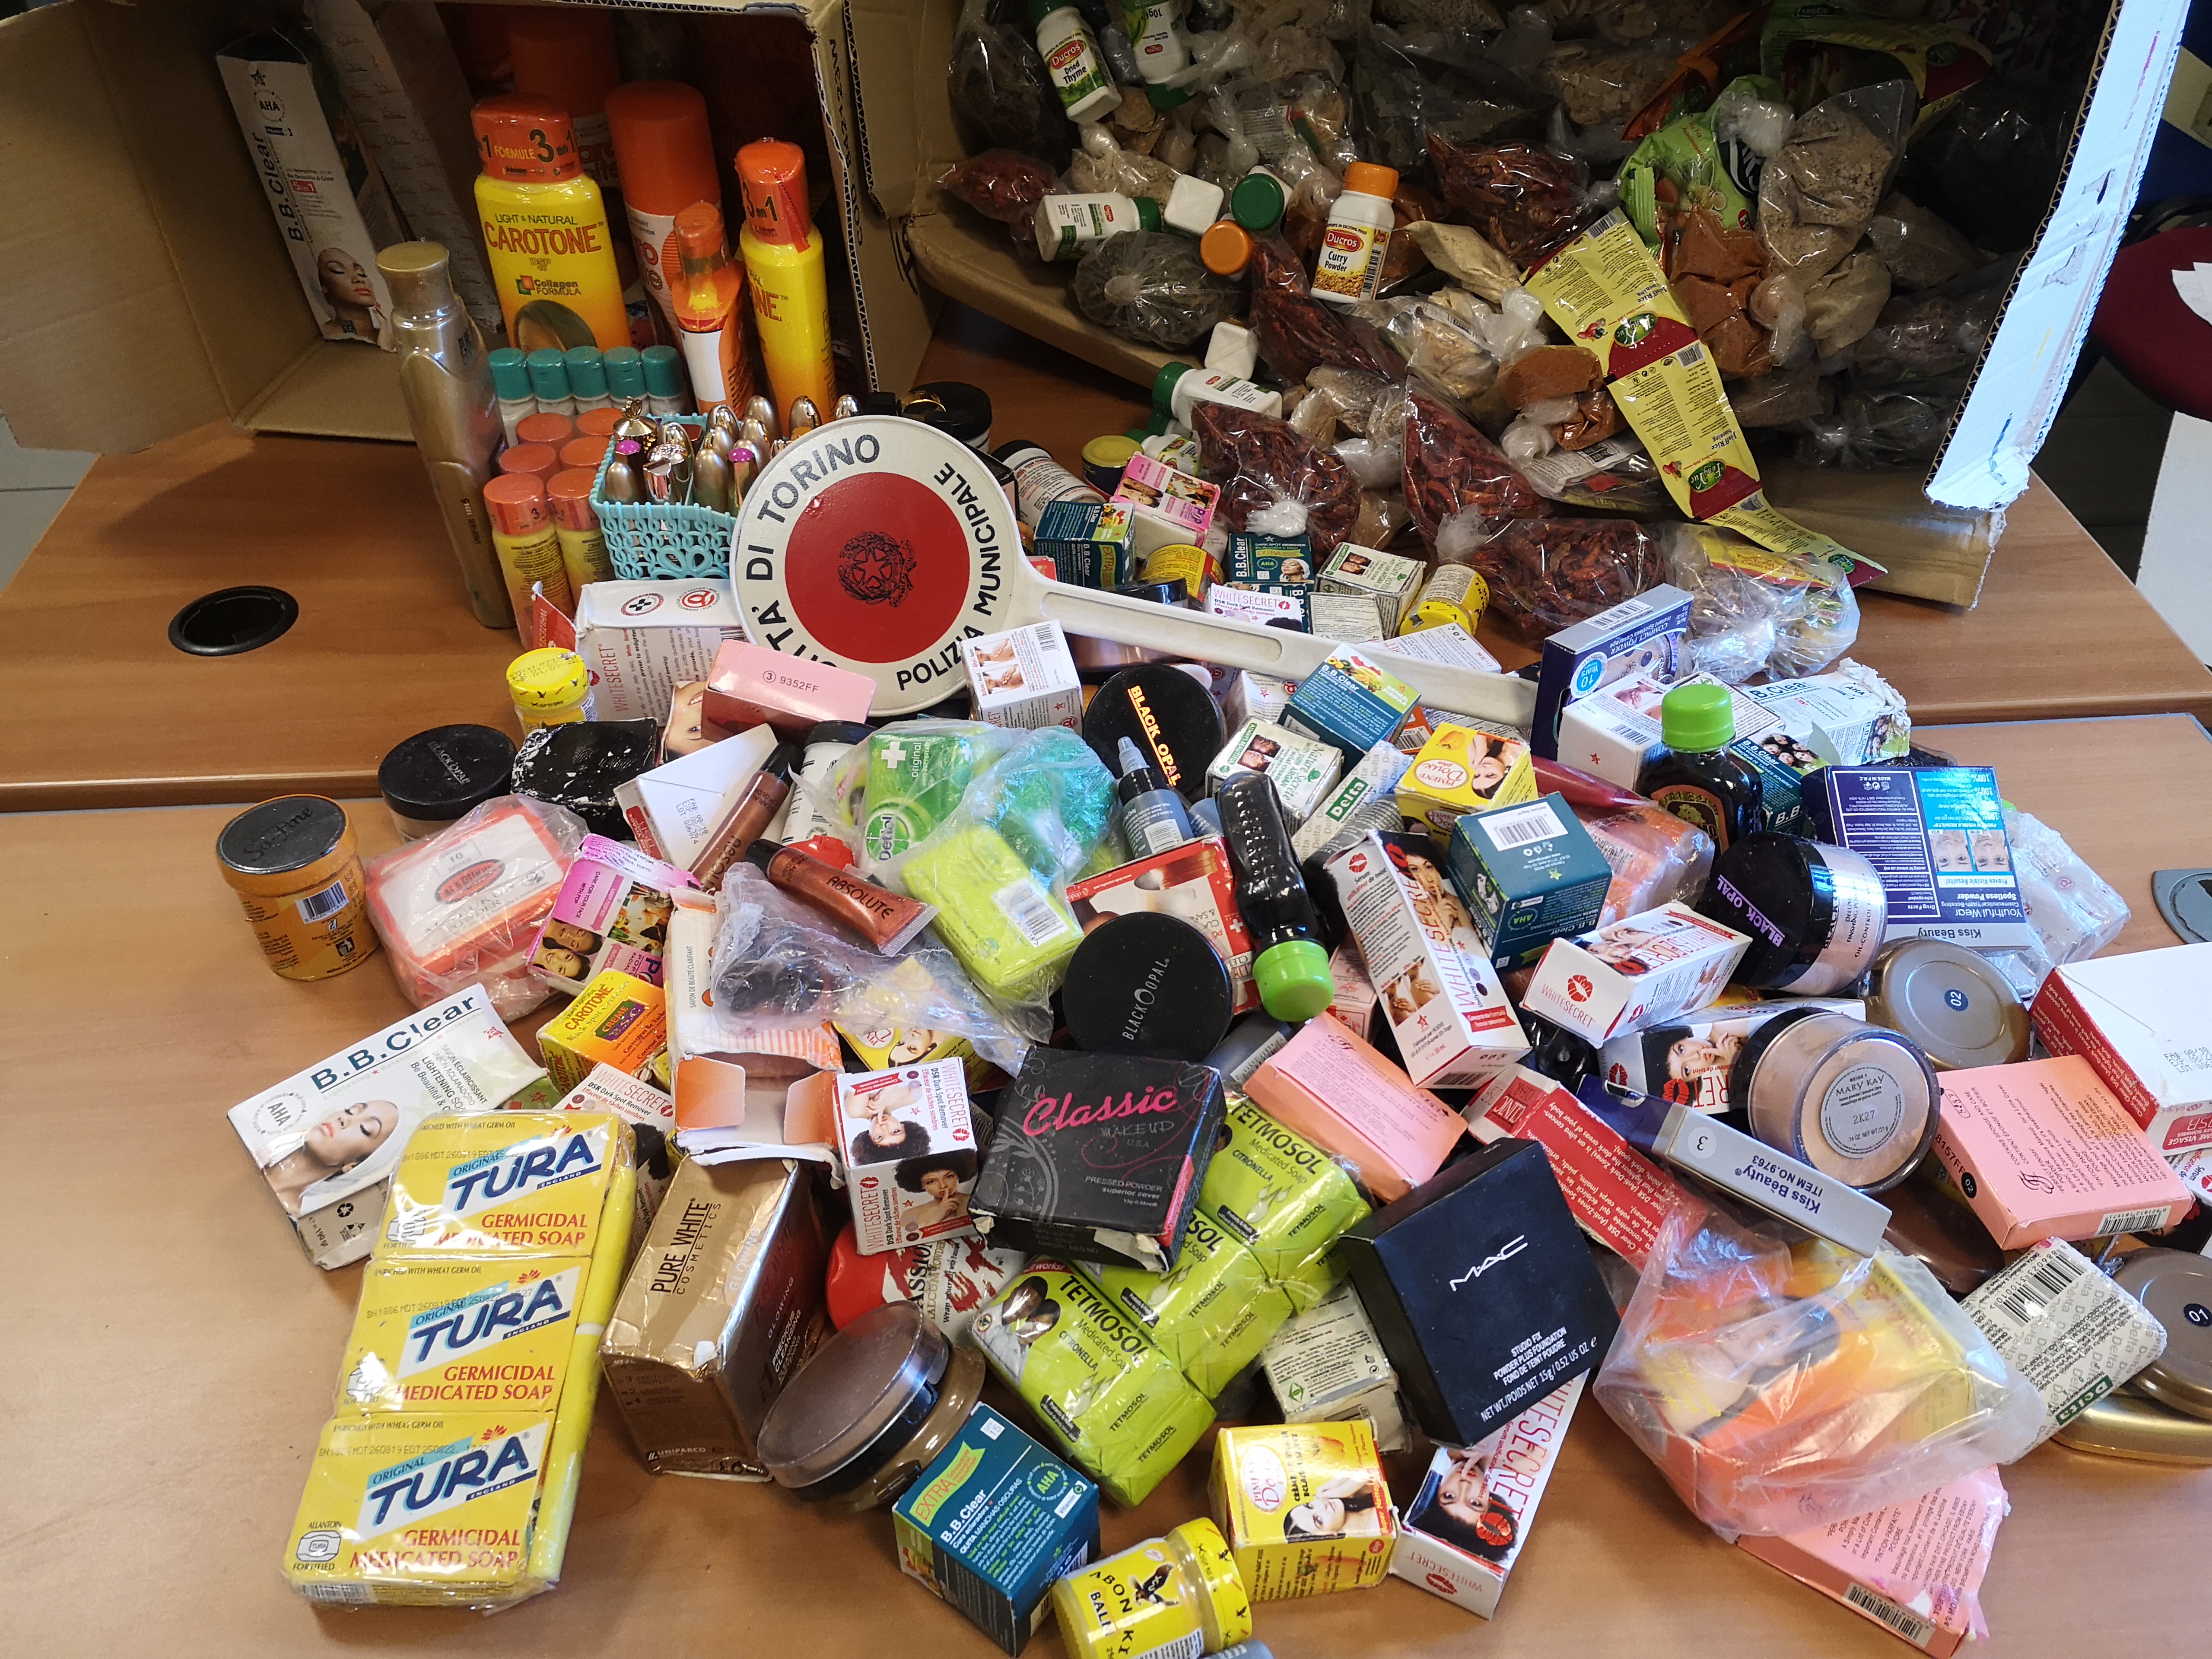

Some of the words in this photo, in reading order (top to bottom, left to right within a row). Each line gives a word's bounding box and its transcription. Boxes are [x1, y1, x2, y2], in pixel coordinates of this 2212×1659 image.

[1050, 42, 1081, 67] Ducros
[1064, 60, 1080, 75] Dried
[1063, 65, 1087, 84] Thyme
[259, 100, 280, 112] AHA
[494, 145, 536, 161] FORMULE
[529, 128, 555, 163] 3
[483, 221, 602, 255] CAROTONE
[1326, 231, 1358, 246] Ducros
[1324, 260, 1348, 273] Powder
[1328, 251, 1348, 264] Curry
[534, 279, 578, 289] Collagen
[536, 286, 582, 296] FORMULA
[756, 434, 880, 524] TORINO
[933, 462, 1001, 616] MUNICIPALE
[746, 544, 775, 581] DI
[1236, 537, 1248, 578] B.B.Clear
[1213, 589, 1280, 608] WHITESECRET
[1611, 638, 1638, 655] POWDER
[1638, 623, 1668, 643] COMPACT
[599, 647, 629, 712] WHITESECRET
[1321, 664, 1360, 692] B.B.Clear
[1581, 664, 1599, 676] Years
[1582, 674, 1594, 688] 10
[779, 676, 820, 693] 9352FF
[1844, 684, 1867, 696] AHA
[1127, 684, 1161, 736] BLACK
[1158, 742, 1182, 787] OPAL
[911, 741, 922, 778] original
[1303, 744, 1324, 772] Nature
[1743, 739, 1780, 766] B.B.Clear
[1283, 772, 1306, 801] Secrete
[878, 815, 895, 861] Dettol
[449, 852, 464, 863] 10
[826, 874, 895, 920] ABSOLUTE
[1716, 873, 1744, 911] OPAL
[1513, 913, 1534, 925] AHA
[1550, 916, 1598, 937] B.B.Clear
[1955, 908, 1981, 918] Wear
[1983, 909, 2023, 918] Youthful
[1397, 869, 1476, 1008] WHITESECRET
[1745, 909, 1787, 949] BLACK
[1918, 928, 1955, 940] Beauty
[1958, 928, 1981, 938] Kiss
[565, 983, 613, 1031] CAROTONE
[1541, 983, 1594, 1029] WHITESECRET
[1950, 991, 1962, 1007] 02
[1122, 1004, 1148, 1041] BLACK
[310, 995, 475, 1091] B.B.Clear
[411, 1062, 420, 1072] Be
[417, 1071, 442, 1100] Beautiful
[422, 1056, 455, 1098] LIGHTENING
[442, 1044, 457, 1063] SAVON
[454, 1061, 487, 1104] ÉCLAIRCISSANT
[1836, 1081, 1863, 1096] MARY
[1867, 1074, 1885, 1087] KAY
[588, 1082, 601, 1091] DSR
[601, 1088, 614, 1098] Dark
[613, 1094, 626, 1104] Spot
[626, 1101, 652, 1116] Remover
[595, 1069, 668, 1110] WHITESECRET
[941, 1062, 969, 1131] WHITESECRET
[267, 1102, 291, 1127] AHA
[1022, 1085, 1178, 1137] Classic
[1853, 1110, 1875, 1125] 2K27
[1231, 1101, 1323, 1175] TETMOSOL
[1548, 1102, 1564, 1116] body
[1562, 1115, 1577, 1127] your
[1582, 1130, 1599, 1146] areas
[1597, 1144, 1611, 1157] dark
[1697, 1136, 1709, 1151] 3
[1232, 1149, 1274, 1182] CITRONELLA
[1249, 1138, 1290, 1171] Medicated
[1286, 1166, 1307, 1184] Soap
[1934, 1133, 1966, 1174] 8157FF
[450, 1133, 594, 1212] TURA
[540, 1171, 582, 1188] ENGLAND
[1751, 1154, 1794, 1182] NO.9763
[1125, 1181, 1163, 1192] POWDER
[1795, 1176, 1824, 1197] ITEM
[1964, 1178, 1974, 1193] 02
[1791, 1188, 1821, 1214] Kiss
[481, 1213, 588, 1228] GERMICIDAL
[862, 1189, 884, 1251] WHITESECRET
[1287, 1204, 1324, 1238] TETMOSOL
[650, 1253, 686, 1294] PURE
[670, 1203, 710, 1252] WHITE
[677, 1203, 721, 1295] COSMETICS
[408, 1266, 425, 1274] WITH
[426, 1266, 450, 1274] WHEAT
[451, 1266, 470, 1274] GERM
[1188, 1281, 1227, 1318] TETMOSOL
[411, 1280, 564, 1362] TURA
[505, 1317, 550, 1338] ENGLAND
[1059, 1274, 1149, 1359] TETMOSOL
[2188, 1308, 2206, 1322] 01
[772, 1310, 796, 1367] PRECIOUS
[774, 1309, 801, 1373] CLEANSING
[1220, 1311, 1256, 1348] TETMOSOL
[2126, 1321, 2142, 1353] Delta
[1058, 1330, 1098, 1371] CITRONELLA
[1075, 1318, 1117, 1358] Medicated
[1113, 1351, 1132, 1375] Soap
[1511, 1338, 1532, 1357] STUDIO
[1532, 1331, 1543, 1343] FIX
[2106, 1336, 2122, 1370] Delta
[444, 1365, 556, 1381] GERMICIDAL
[502, 1384, 553, 1400] SOAP
[2059, 1380, 2107, 1420] Delta
[1109, 1391, 1148, 1433] TETMOSOL
[657, 1447, 707, 1457] UNIPARCO
[1138, 1424, 1176, 1463] TETMOSOL
[368, 1436, 530, 1526] TURA
[373, 1457, 426, 1484] ORIGINAL
[1036, 1471, 1059, 1494] AHA
[470, 1479, 515, 1500] ENGLAND
[915, 1478, 958, 1521] EXTRA
[308, 1521, 343, 1529] ALLANTOIN
[941, 1489, 987, 1543] B.B.Clear
[404, 1529, 520, 1547] GERMICIDAL
[292, 1562, 335, 1571] FORTIFIED
[467, 1552, 519, 1570] SOAP
